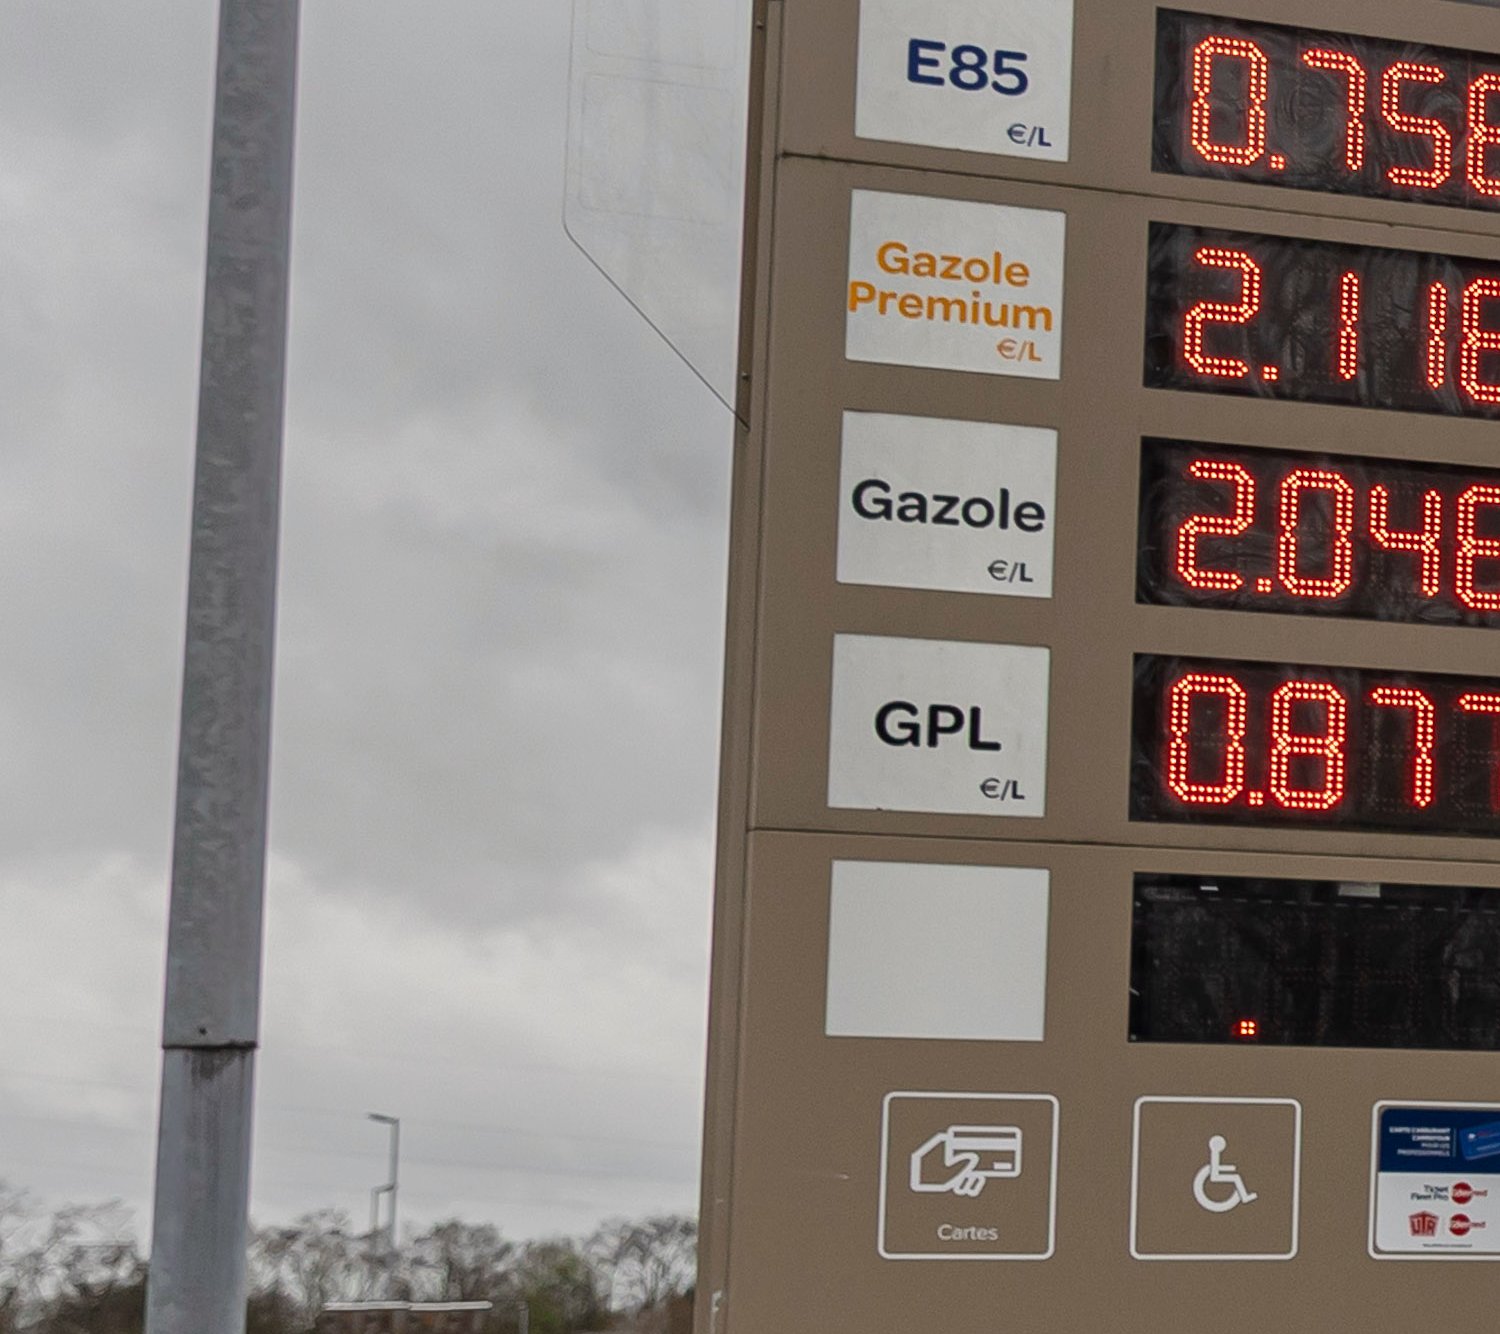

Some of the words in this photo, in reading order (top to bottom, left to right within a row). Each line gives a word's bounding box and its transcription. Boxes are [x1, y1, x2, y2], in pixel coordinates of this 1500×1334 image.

[905, 37, 1030, 98] E85
[1006, 122, 1053, 149] €/L
[876, 239, 1032, 289] Gazole
[847, 279, 1054, 333] Premium
[996, 336, 1043, 365] €/L
[850, 477, 1047, 534] Gazole
[986, 558, 1035, 584] €/L
[873, 699, 1003, 753] GPL
[978, 776, 1027, 802] €/L
[937, 1223, 999, 1242] Cartes
